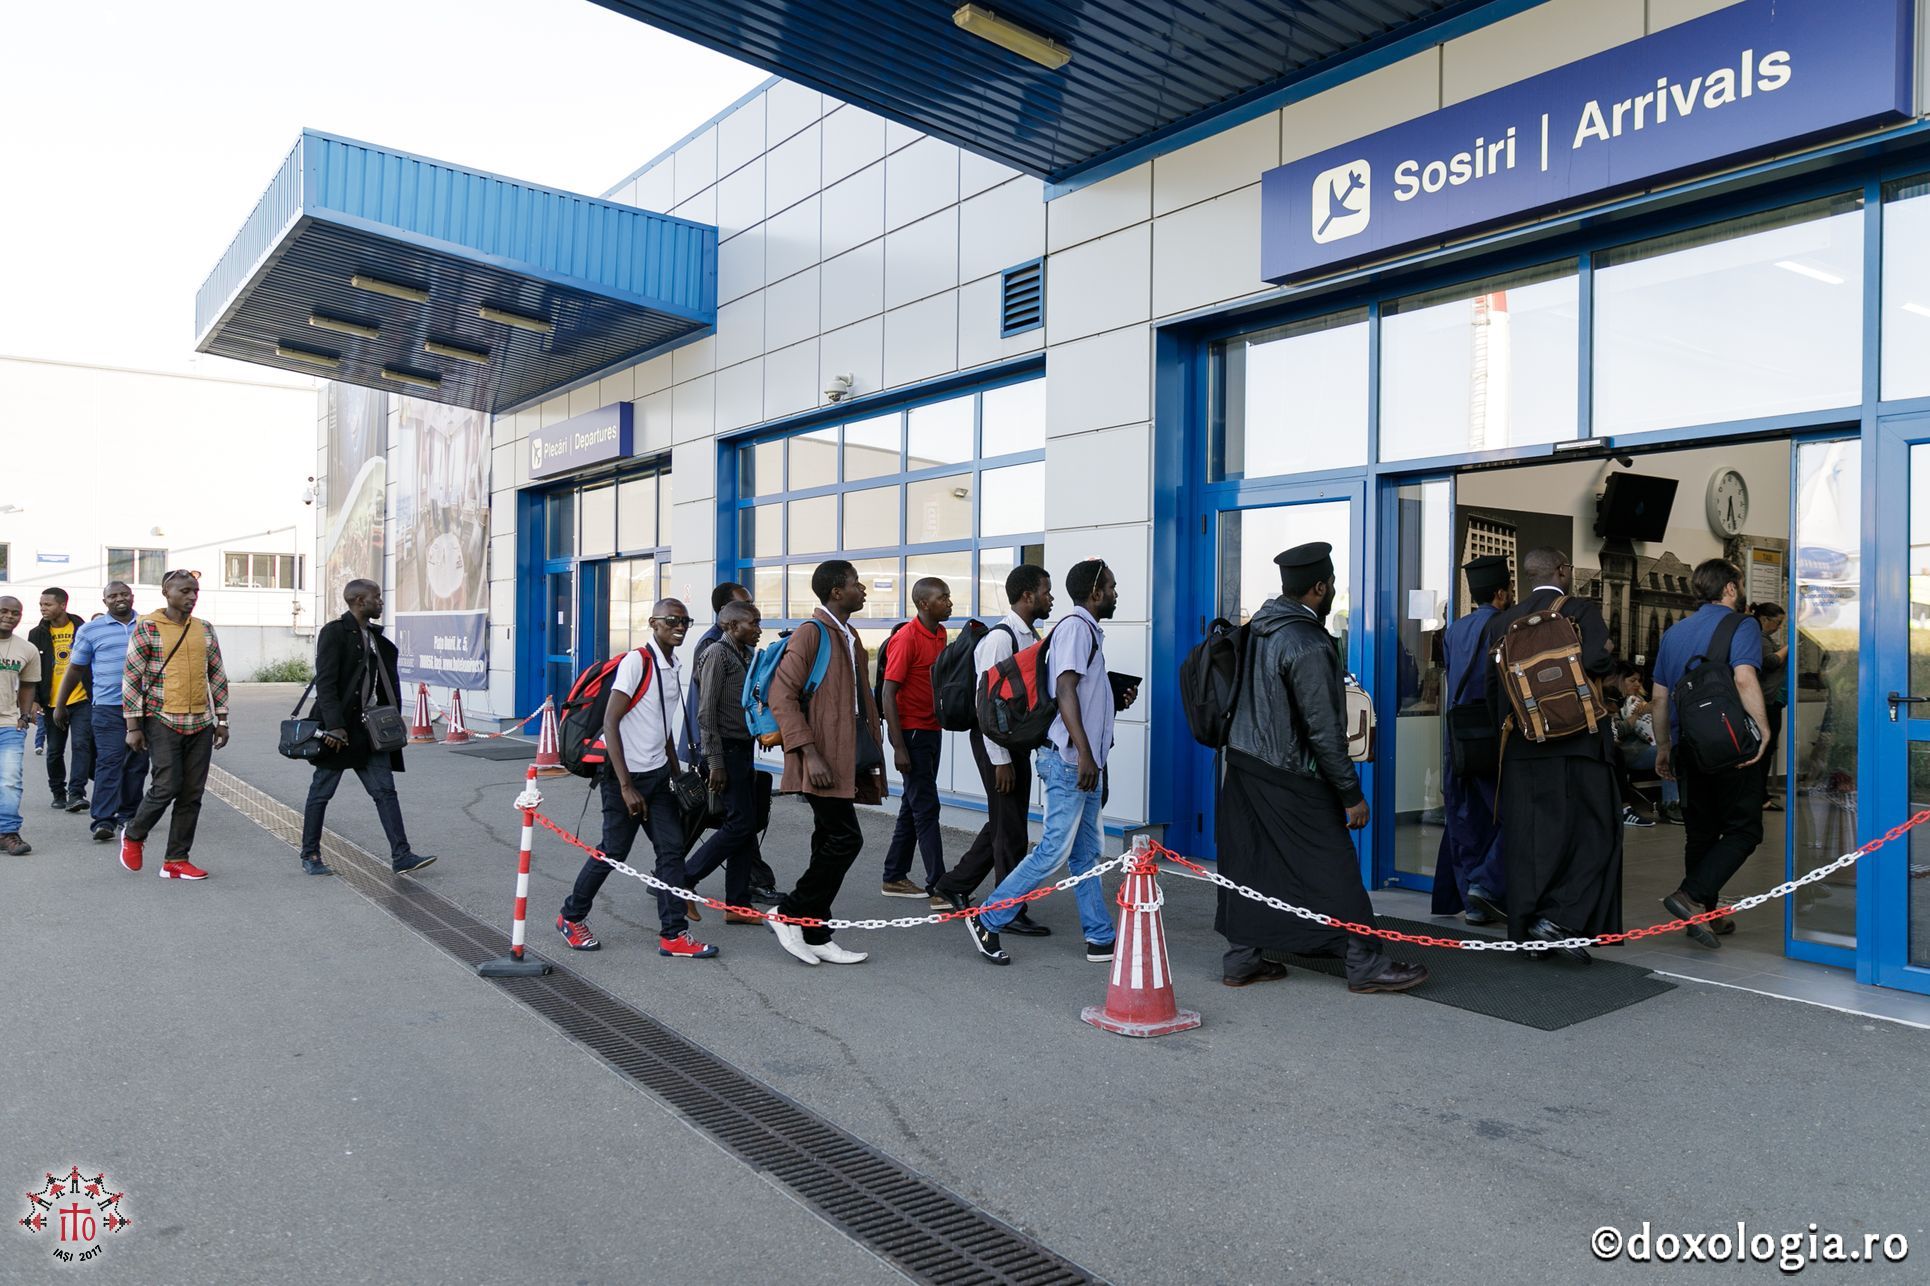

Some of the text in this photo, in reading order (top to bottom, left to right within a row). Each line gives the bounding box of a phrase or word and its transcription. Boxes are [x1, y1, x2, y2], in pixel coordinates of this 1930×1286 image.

[1393, 47, 1793, 203] Sosiri Arrivals
[574, 425, 617, 452] Departures
